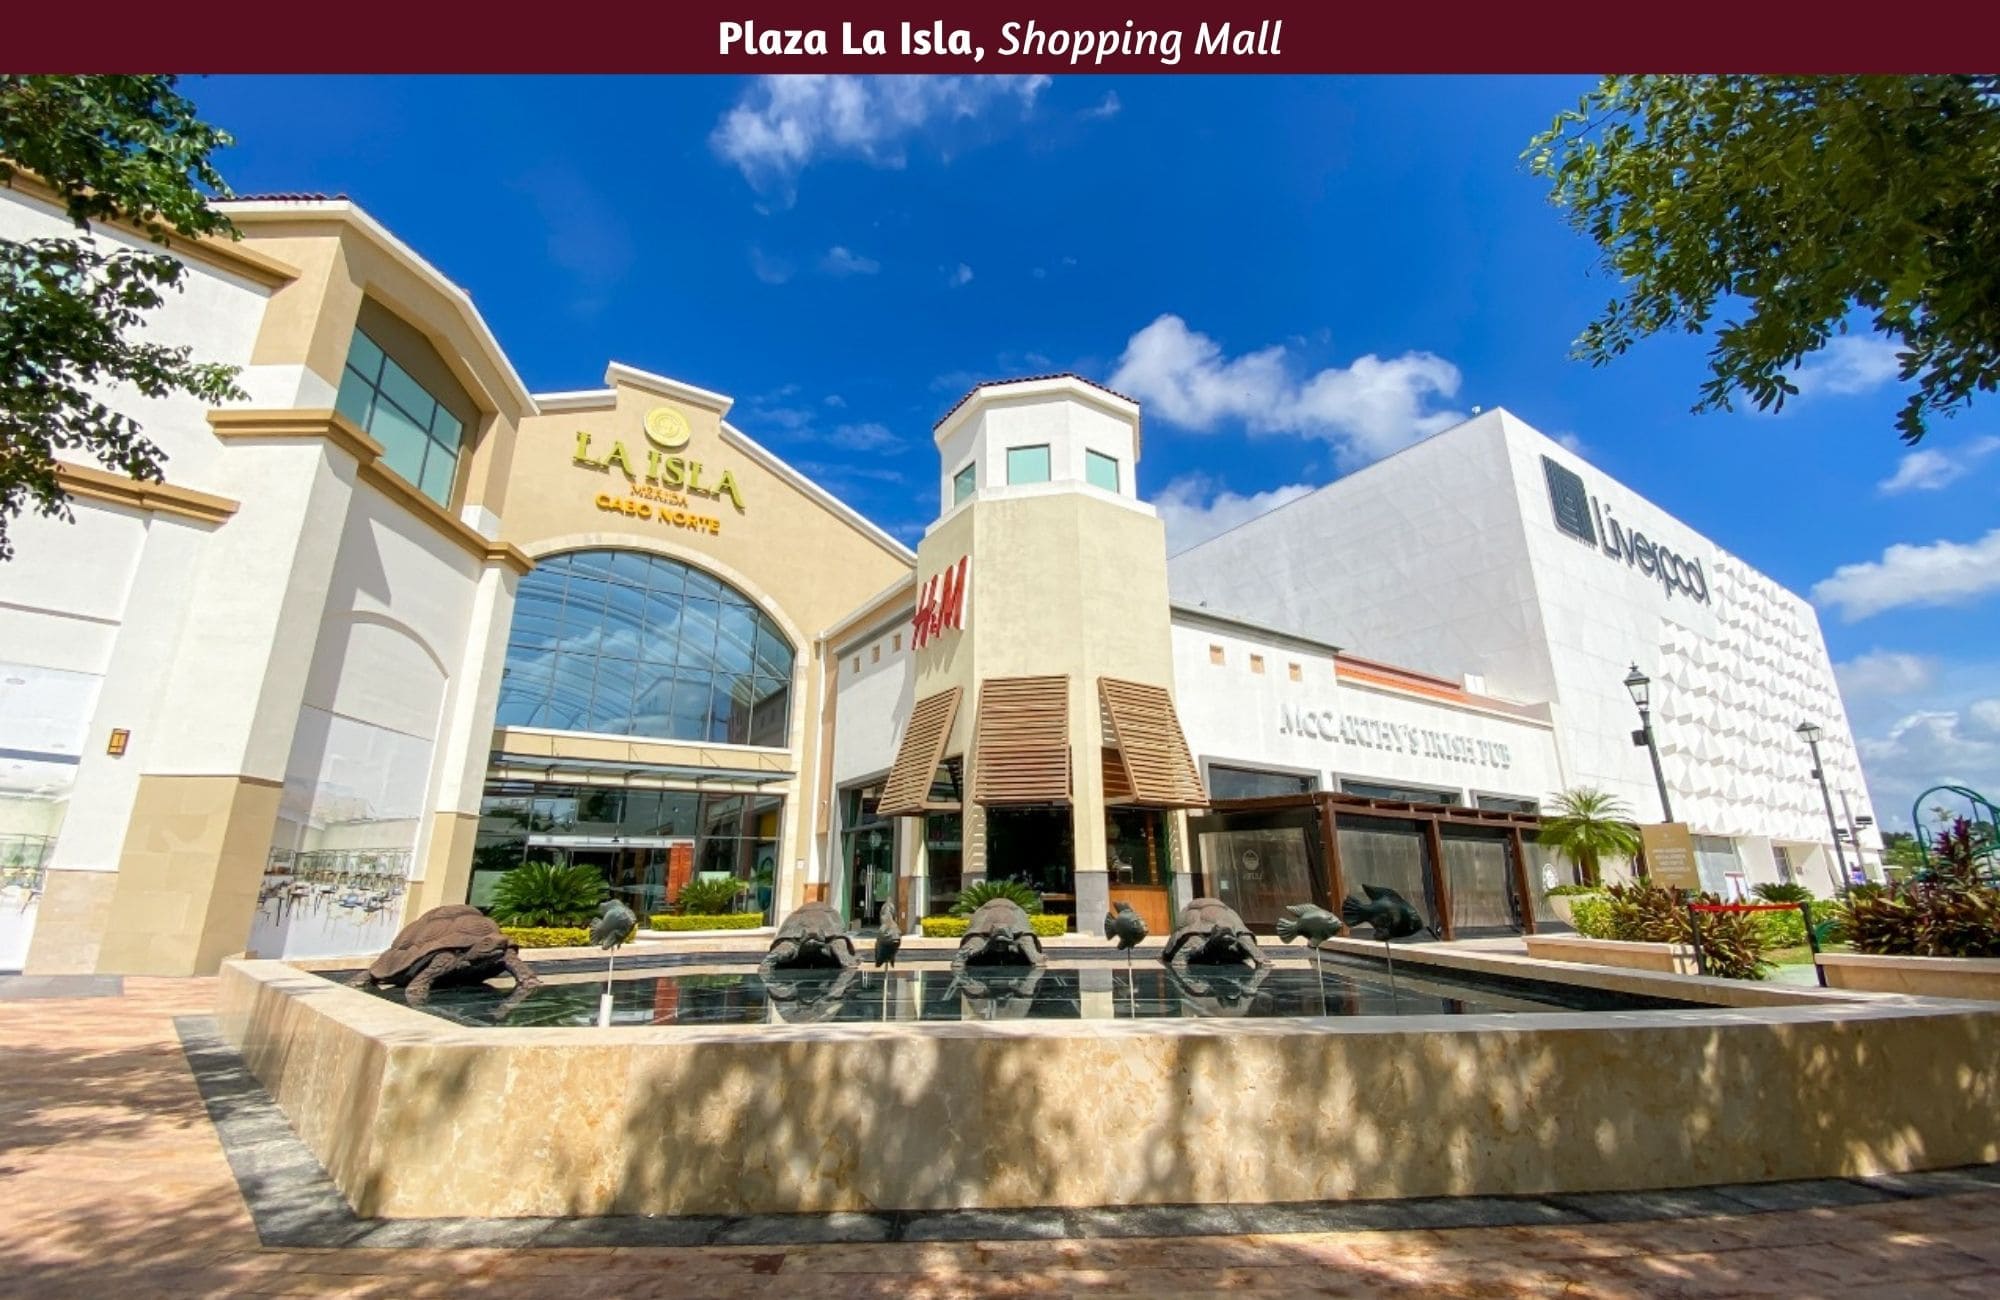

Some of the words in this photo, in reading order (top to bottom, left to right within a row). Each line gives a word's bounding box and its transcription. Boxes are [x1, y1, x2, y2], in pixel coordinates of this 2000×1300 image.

[573, 431, 637, 483] LA
[646, 449, 746, 516] ISLA
[595, 491, 653, 521] CABO
[657, 506, 721, 537] NORTE
[1589, 495, 1712, 608] Liverpool
[911, 554, 972, 652] H&M
[1420, 728, 1477, 766] IRISH
[1475, 738, 1512, 771] PUB
